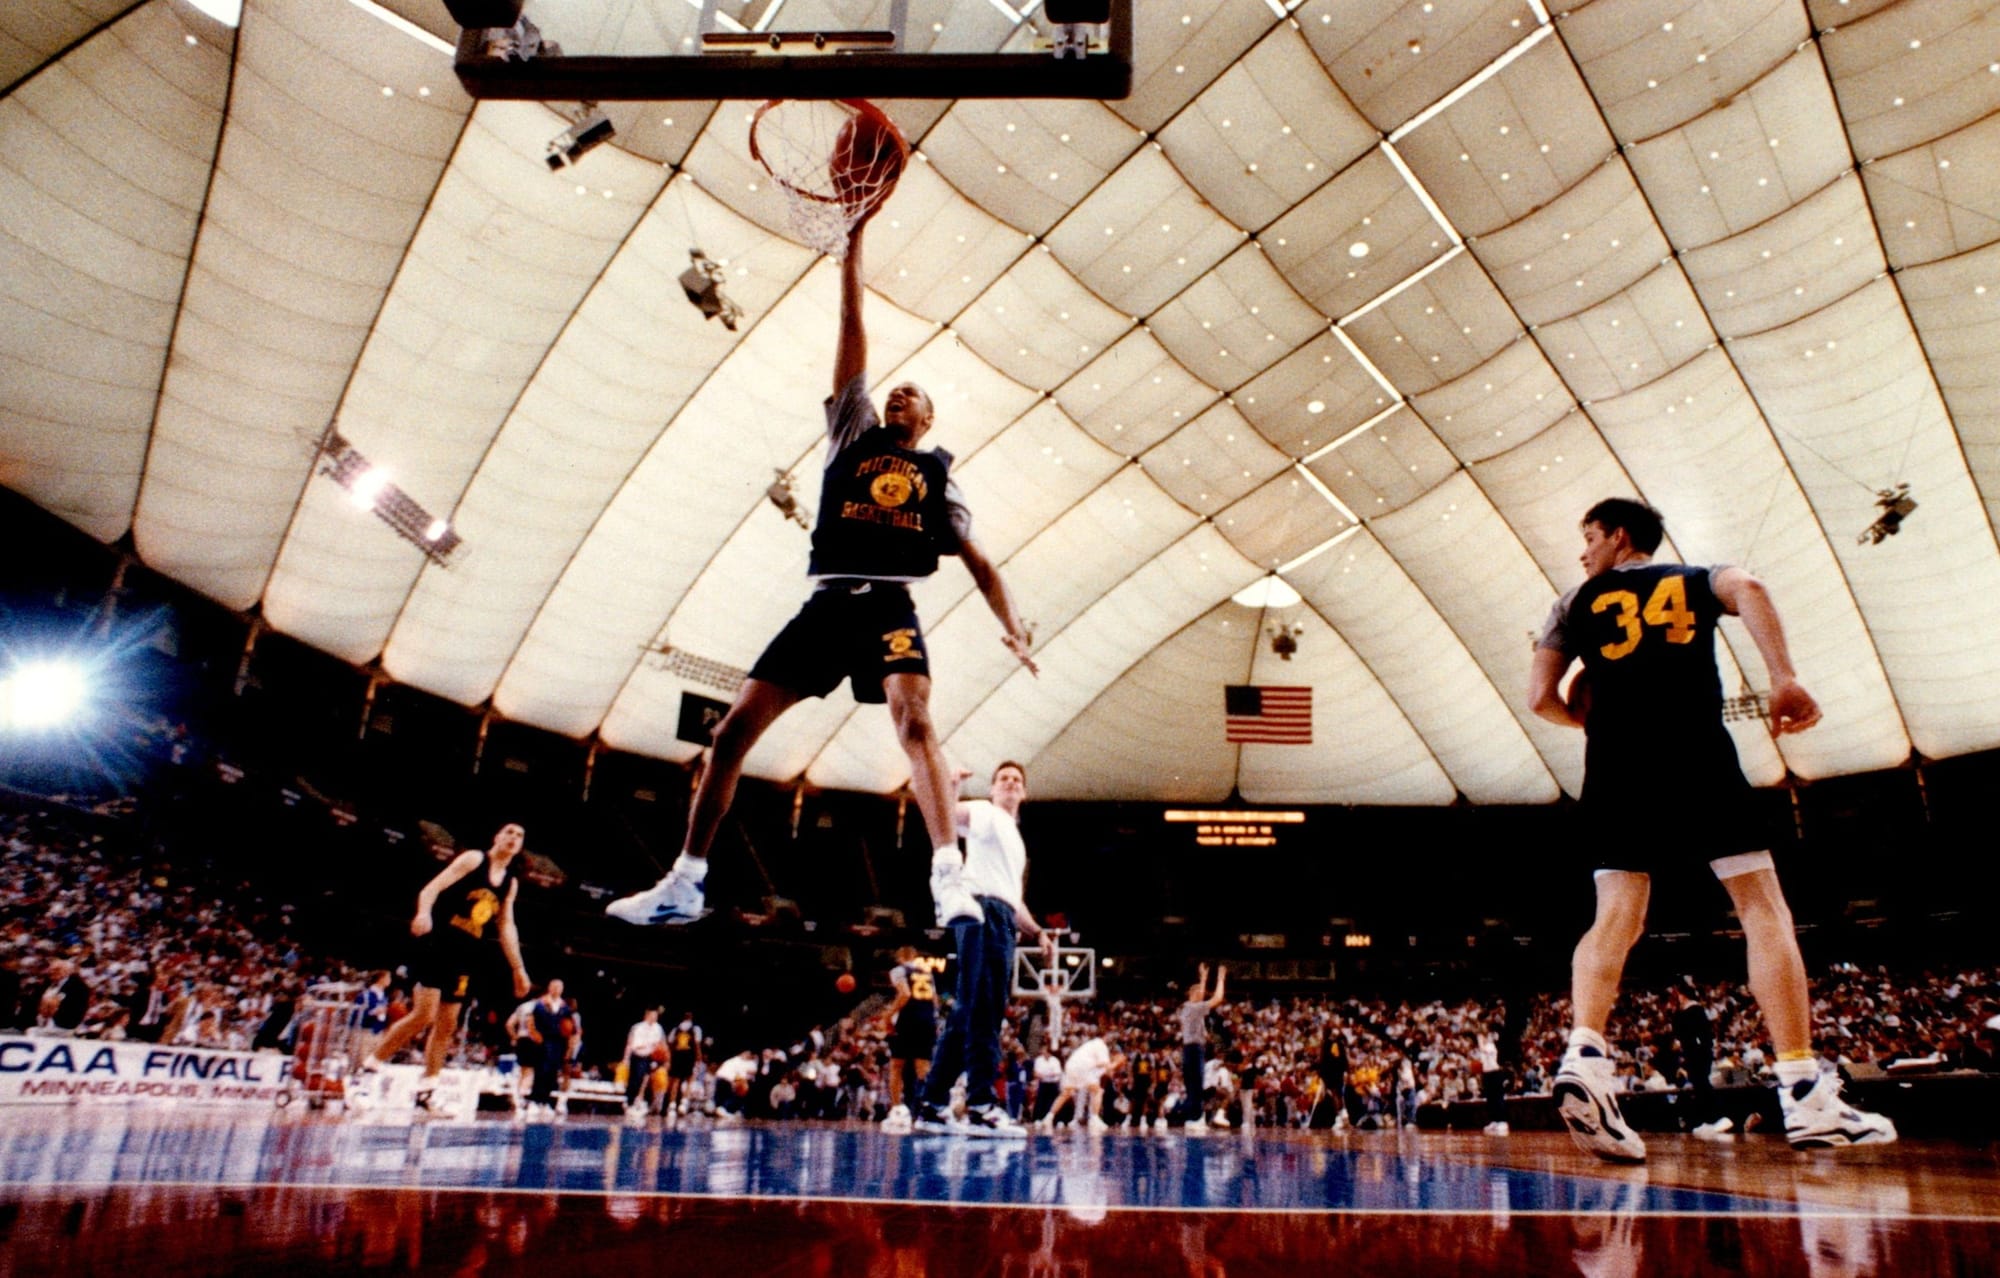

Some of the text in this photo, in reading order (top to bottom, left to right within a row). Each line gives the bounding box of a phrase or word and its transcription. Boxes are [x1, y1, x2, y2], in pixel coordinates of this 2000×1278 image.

[856, 456, 928, 502] MICHIGAN
[841, 500, 924, 532] BASKETBALL
[1590, 574, 1696, 660] 34
[0, 1042, 118, 1075] CAA
[143, 1051, 261, 1082] FINAL
